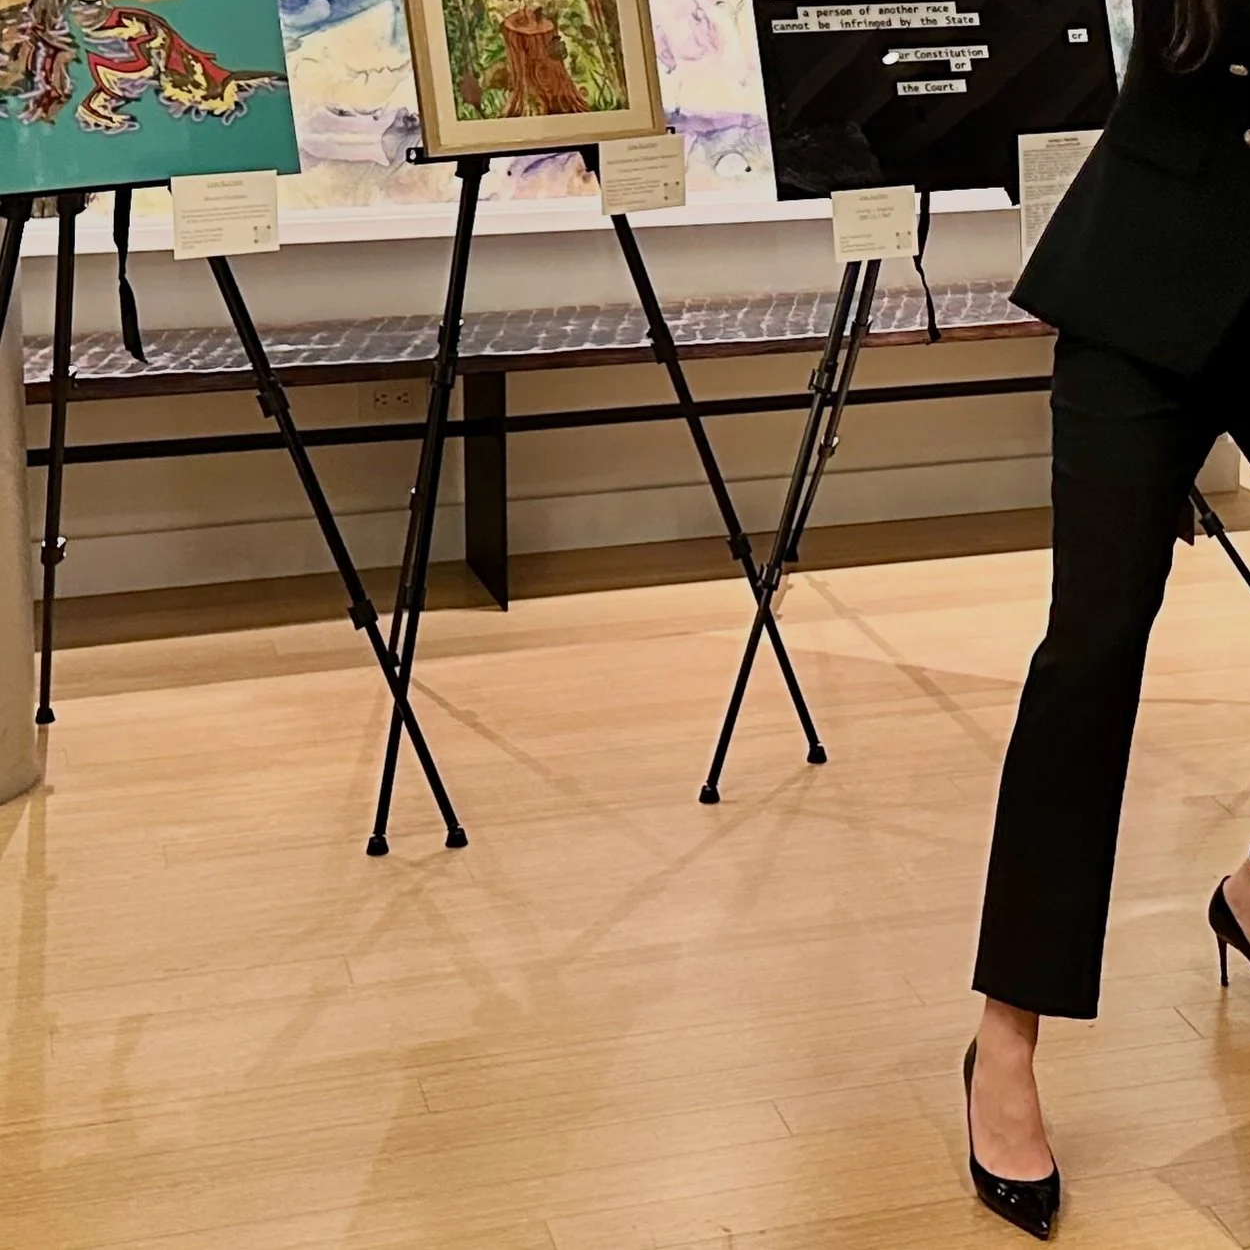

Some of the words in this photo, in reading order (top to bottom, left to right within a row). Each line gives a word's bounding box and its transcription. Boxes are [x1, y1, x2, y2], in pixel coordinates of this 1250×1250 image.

[816, 8, 852, 19] person
[859, 6, 870, 15] of
[879, 5, 919, 15] another
[926, 5, 949, 13] race
[773, 21, 809, 31] cannot
[818, 20, 830, 30] be
[840, 19, 893, 30] infringed
[899, 18, 912, 28] by
[920, 17, 937, 26] the
[945, 15, 974, 25] State
[914, 48, 984, 59] Constitution
[954, 61, 966, 69] or
[902, 84, 920, 93] the
